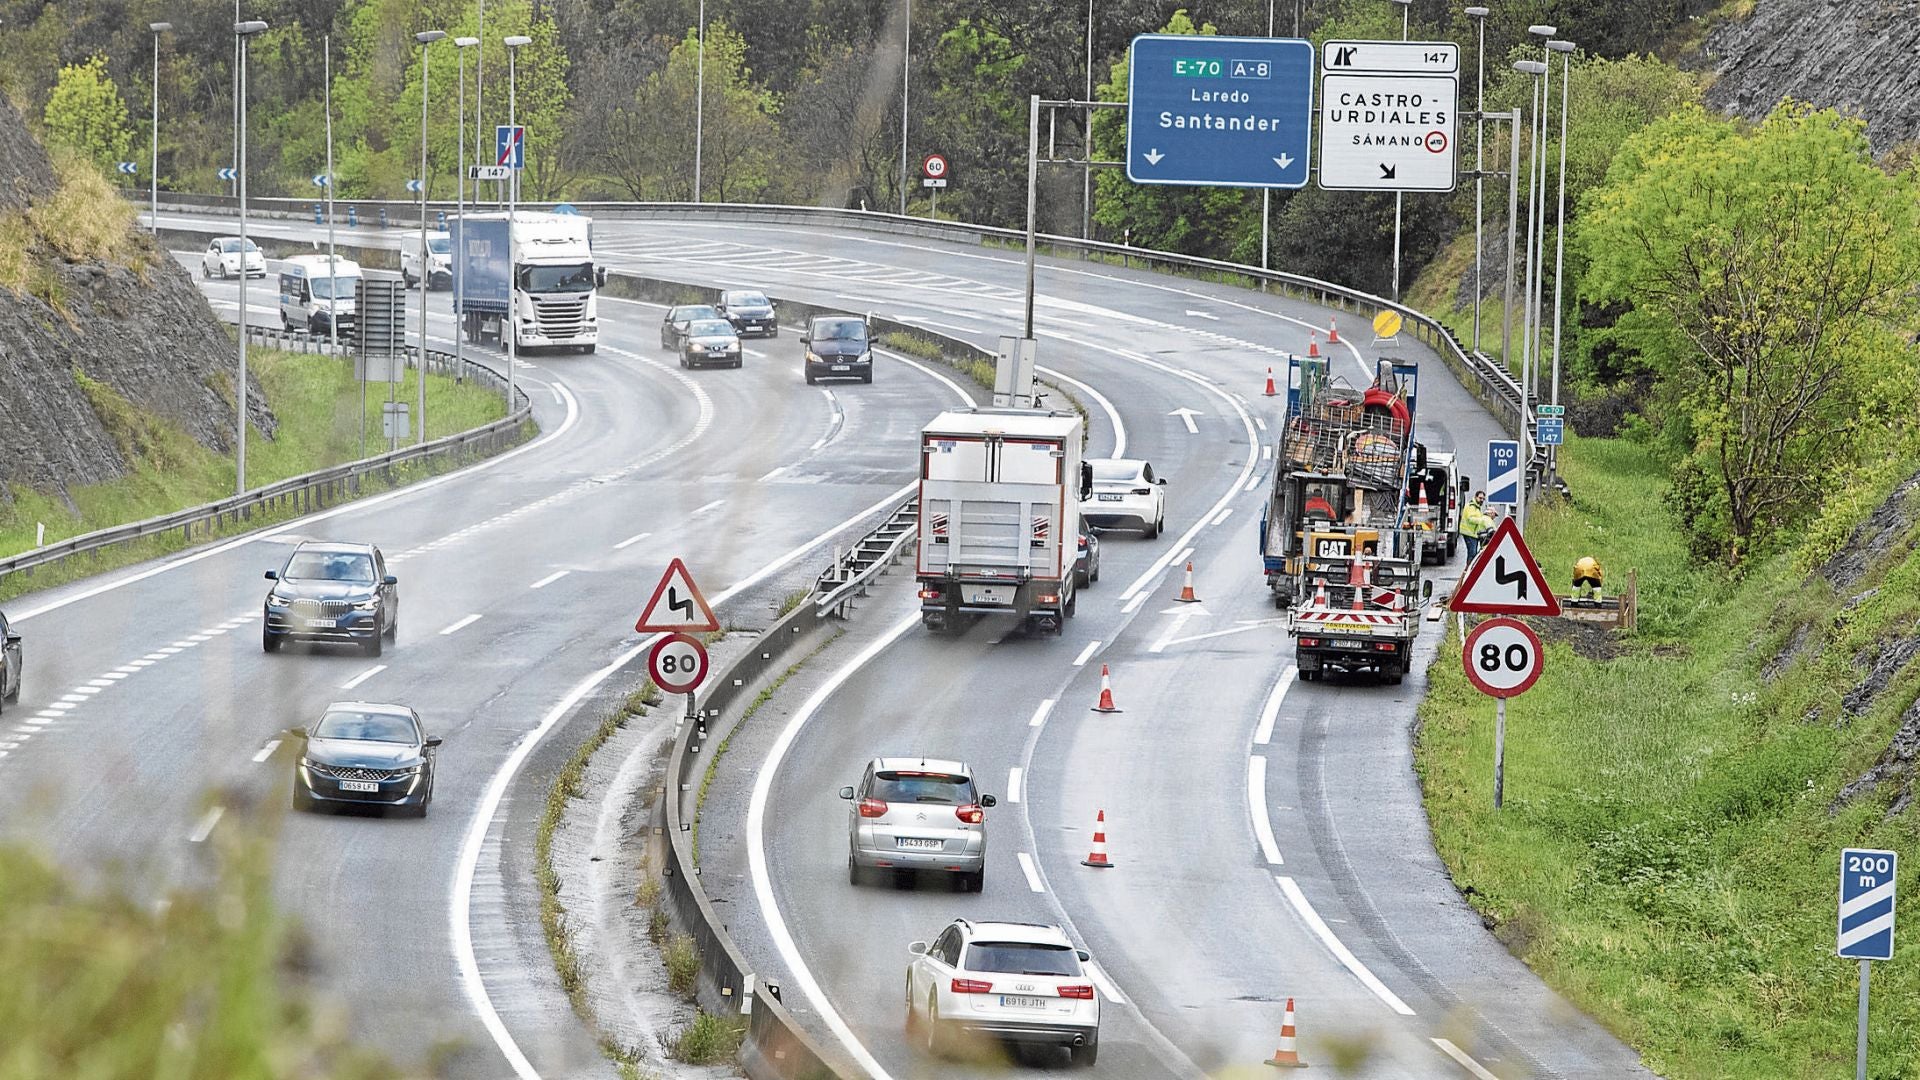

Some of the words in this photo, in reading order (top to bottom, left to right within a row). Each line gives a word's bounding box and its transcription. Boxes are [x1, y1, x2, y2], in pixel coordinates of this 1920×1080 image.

[1424, 53, 1448, 63] 147
[1176, 61, 1220, 75] E-70
[1234, 63, 1268, 76] A-8
[1191, 88, 1249, 103] Laredo
[1159, 111, 1280, 131] Santander
[1331, 109, 1446, 124] URDIALES
[1352, 133, 1423, 146] SÁMANO
[488, 168, 504, 176] 147
[929, 162, 942, 171] 60
[1542, 434, 1558, 442] 147
[1493, 448, 1514, 458] 100
[1319, 540, 1347, 556] CAT
[662, 655, 696, 674] 80
[1480, 644, 1528, 672] 80
[905, 838, 923, 847] 5433
[1848, 856, 1889, 873] 200
[1860, 875, 1876, 887] m
[1005, 996, 1027, 1006] 6916
[1029, 998, 1046, 1007] JTH
